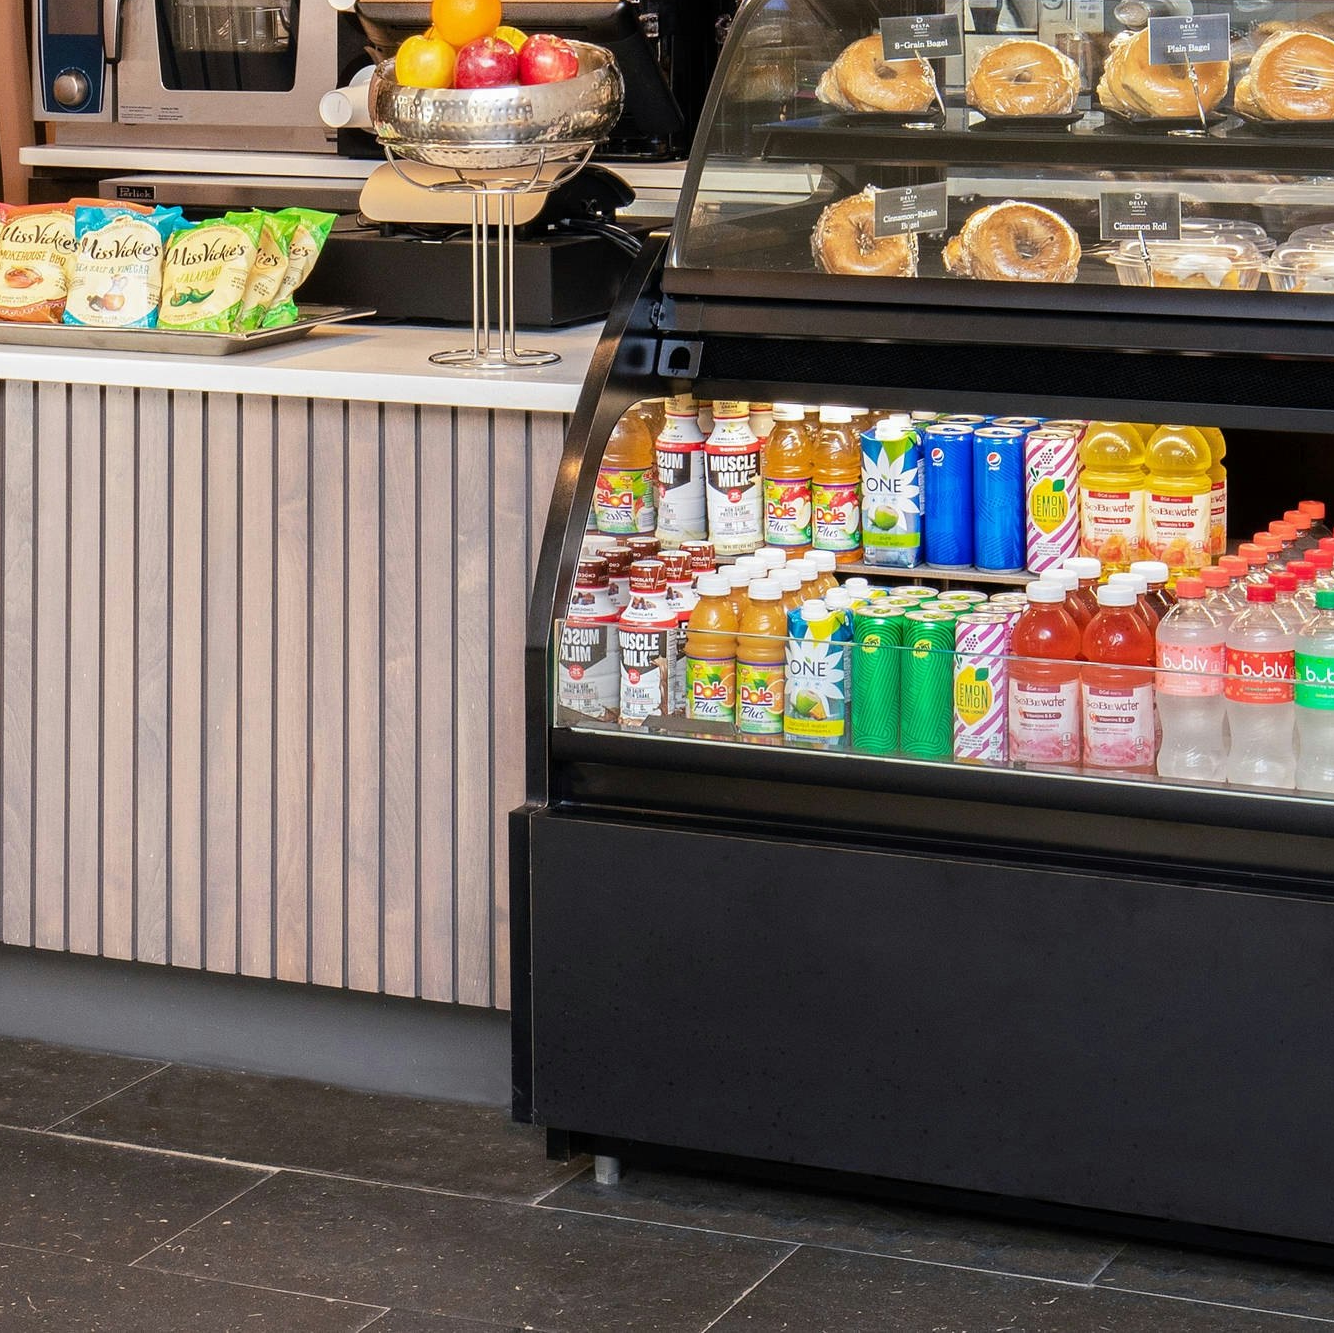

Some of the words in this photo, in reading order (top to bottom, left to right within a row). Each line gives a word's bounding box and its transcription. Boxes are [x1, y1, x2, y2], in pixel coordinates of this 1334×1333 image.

[927, 39, 948, 47] Bagel
[1167, 44, 1186, 53] Plain
[1189, 43, 1210, 52] Bagel
[119, 187, 152, 197] Perlick
[883, 209, 938, 223] Cinnamon-Raisin
[1114, 222, 1150, 230] Cinnamon
[1152, 222, 1167, 230] Roll
[35, 222, 80, 254] Vickie's
[82, 237, 114, 259] Miss
[114, 234, 161, 262] Vickie's
[164, 247, 202, 266] Miss
[203, 238, 246, 263] Vickie's
[50, 252, 66, 266] BBQ
[711, 454, 756, 467] MUSCLE
[718, 472, 748, 487] MILK
[866, 477, 902, 492] ONE
[768, 502, 797, 518] Dole
[816, 507, 846, 522] Dole
[768, 520, 788, 532] Plus
[817, 525, 838, 537] Plus
[619, 632, 659, 650] MUSCLE
[624, 651, 649, 666] MILK
[1163, 653, 1208, 673] bubly
[790, 660, 826, 677] ONE
[1241, 661, 1288, 679] bubly
[694, 681, 726, 698] Dole
[742, 687, 772, 702] Dole
[695, 701, 718, 714] Plus
[742, 706, 764, 719] Plus
